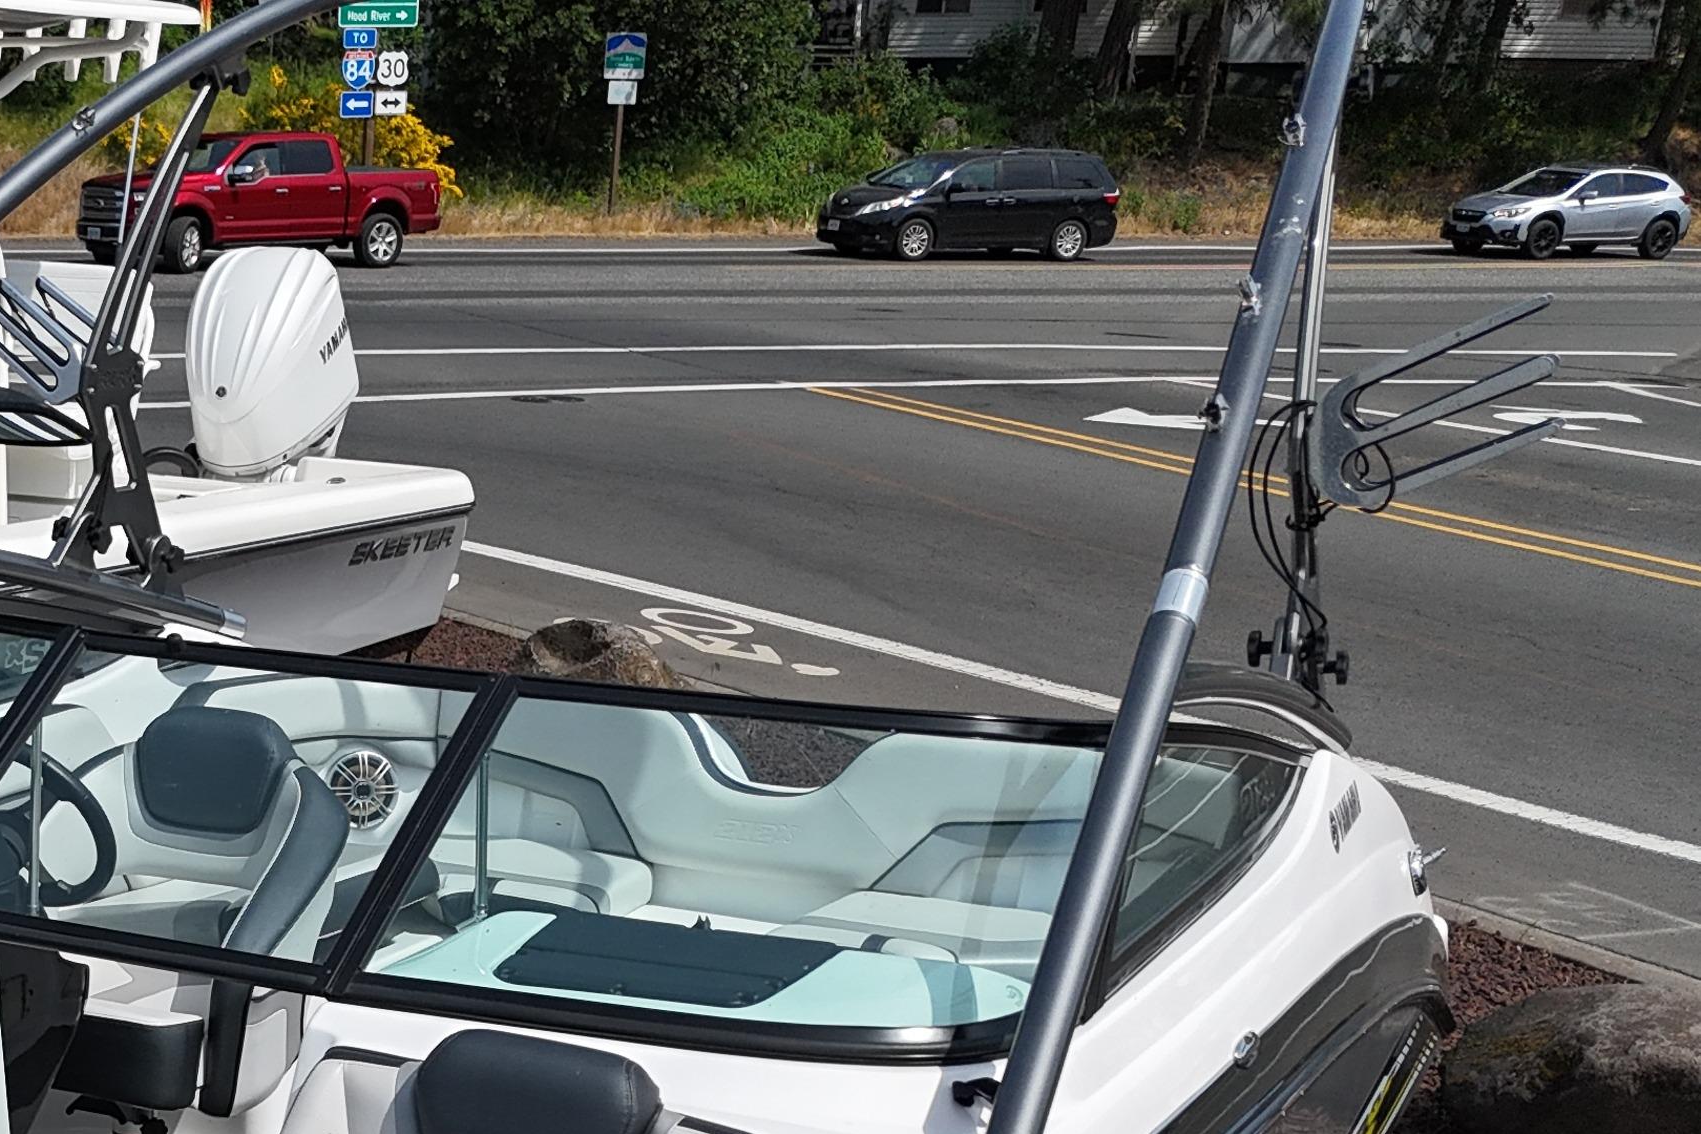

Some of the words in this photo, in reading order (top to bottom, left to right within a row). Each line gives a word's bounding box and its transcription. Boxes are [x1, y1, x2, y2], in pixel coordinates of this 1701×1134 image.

[347, 10, 368, 21] Hood
[371, 10, 391, 21] River
[353, 32, 368, 44] TO
[346, 60, 371, 81] 84
[381, 58, 405, 78] 30
[348, 525, 456, 566] SKEETER
